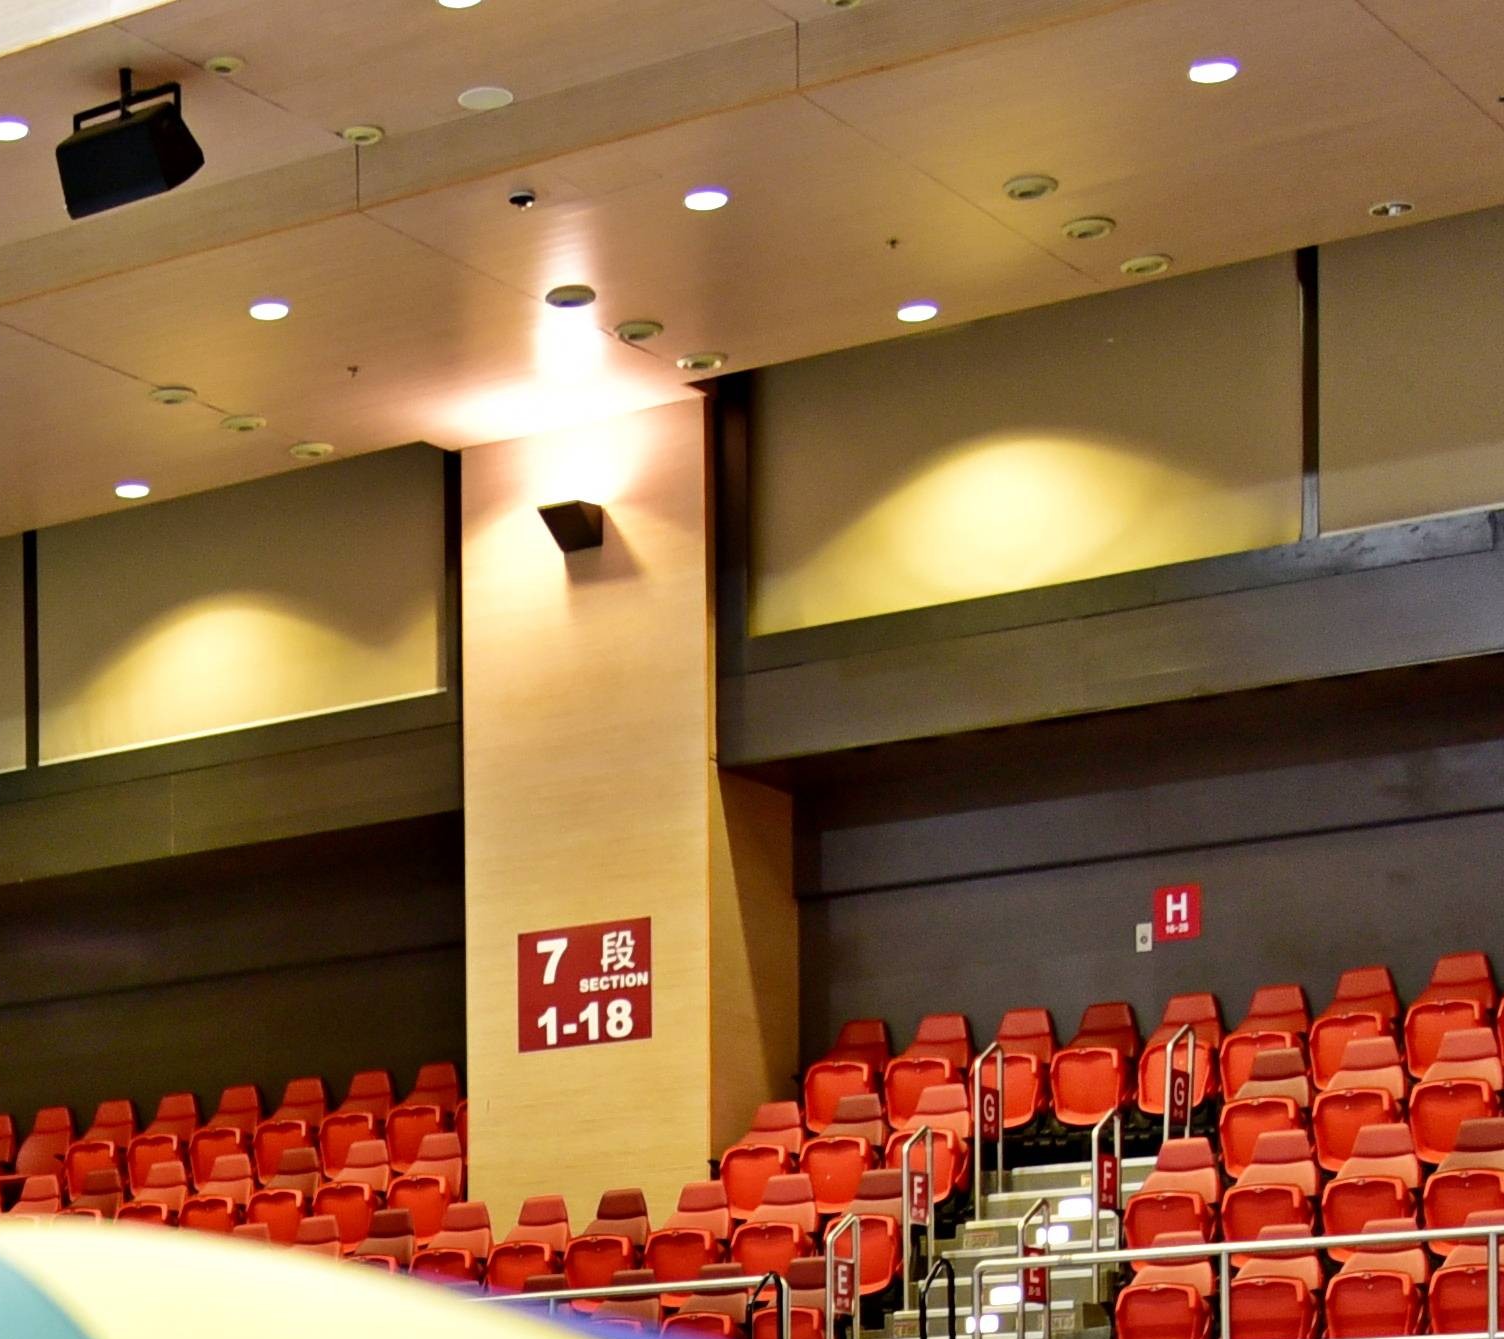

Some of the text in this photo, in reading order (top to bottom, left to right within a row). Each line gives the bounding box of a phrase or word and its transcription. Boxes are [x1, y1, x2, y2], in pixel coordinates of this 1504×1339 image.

[1166, 892, 1188, 923] H
[536, 937, 569, 985] 7
[600, 930, 636, 973] 段
[579, 971, 649, 993] SECTION
[537, 998, 634, 1046] 1-18
[1174, 1076, 1186, 1107] G
[983, 1093, 996, 1123] G
[913, 1175, 924, 1205] F
[1102, 1161, 1113, 1191] F
[837, 1263, 849, 1296] E
